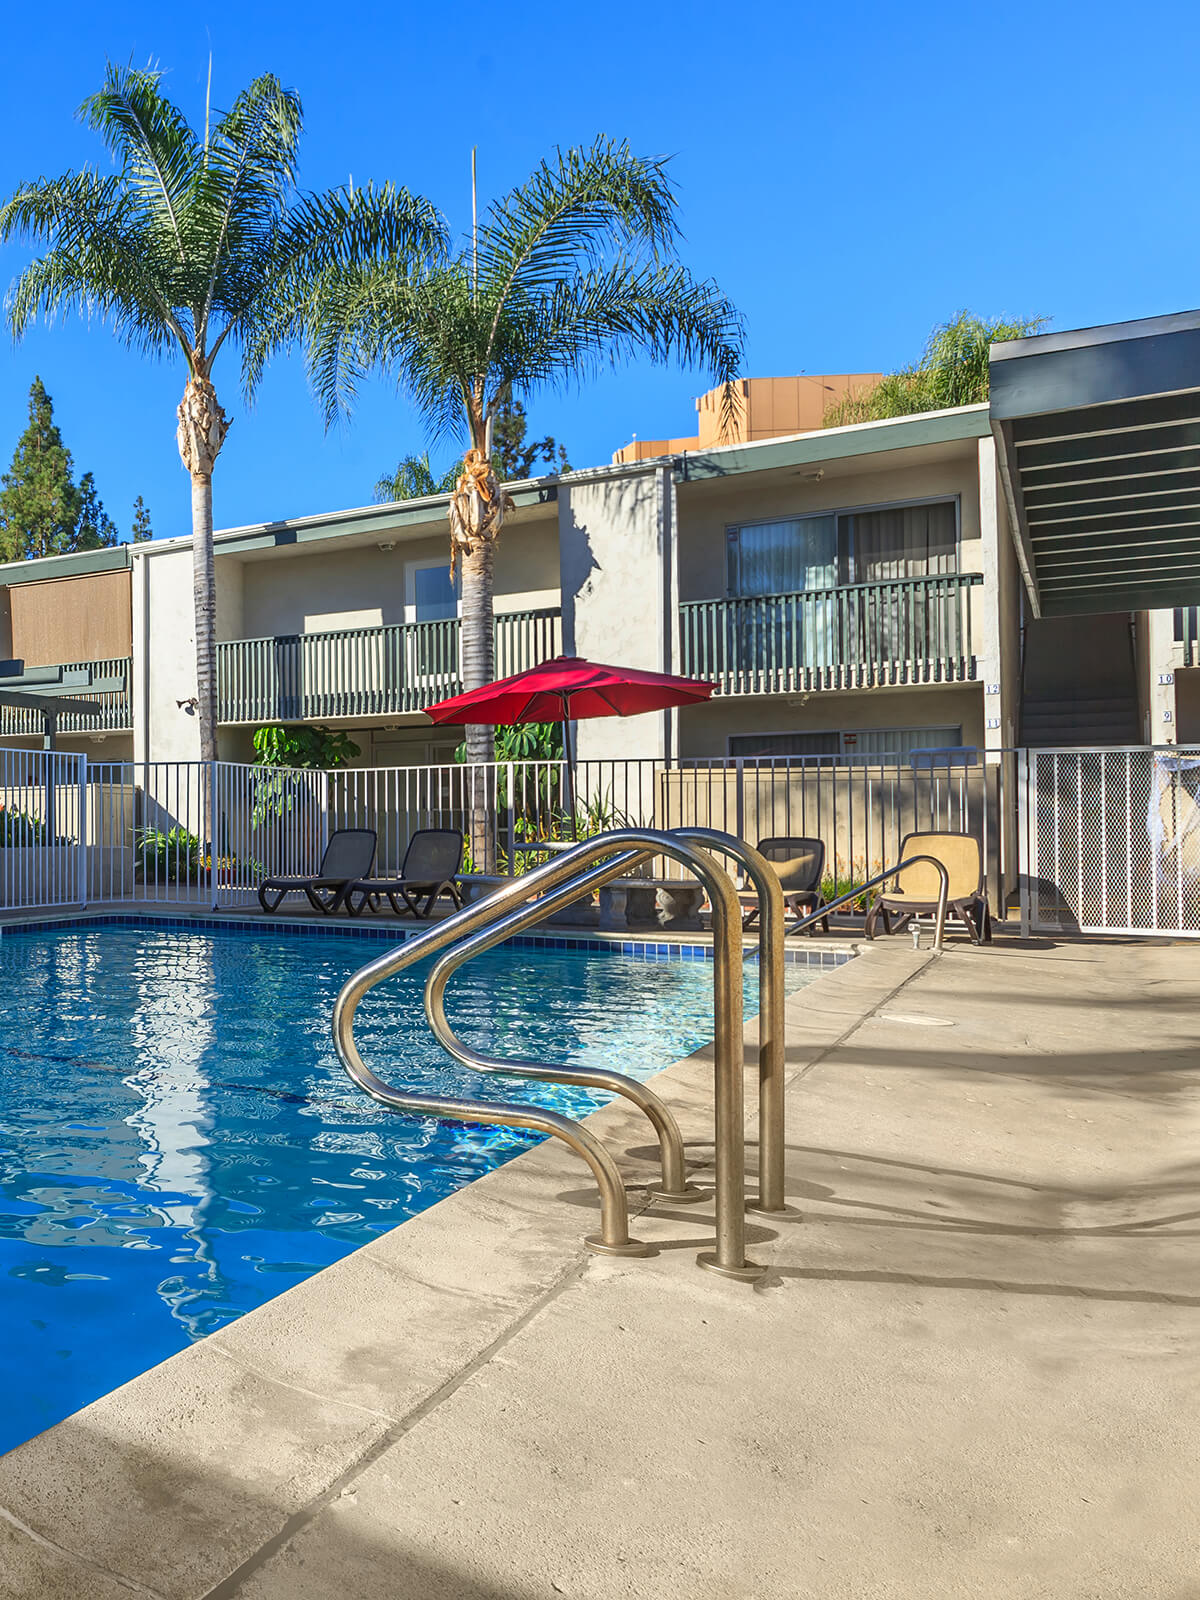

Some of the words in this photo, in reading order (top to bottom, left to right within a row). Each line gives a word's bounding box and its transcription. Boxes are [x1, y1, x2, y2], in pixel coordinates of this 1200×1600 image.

[1159, 674, 1172, 684] 10
[986, 684, 999, 693] 12
[987, 719, 998, 728] 11
